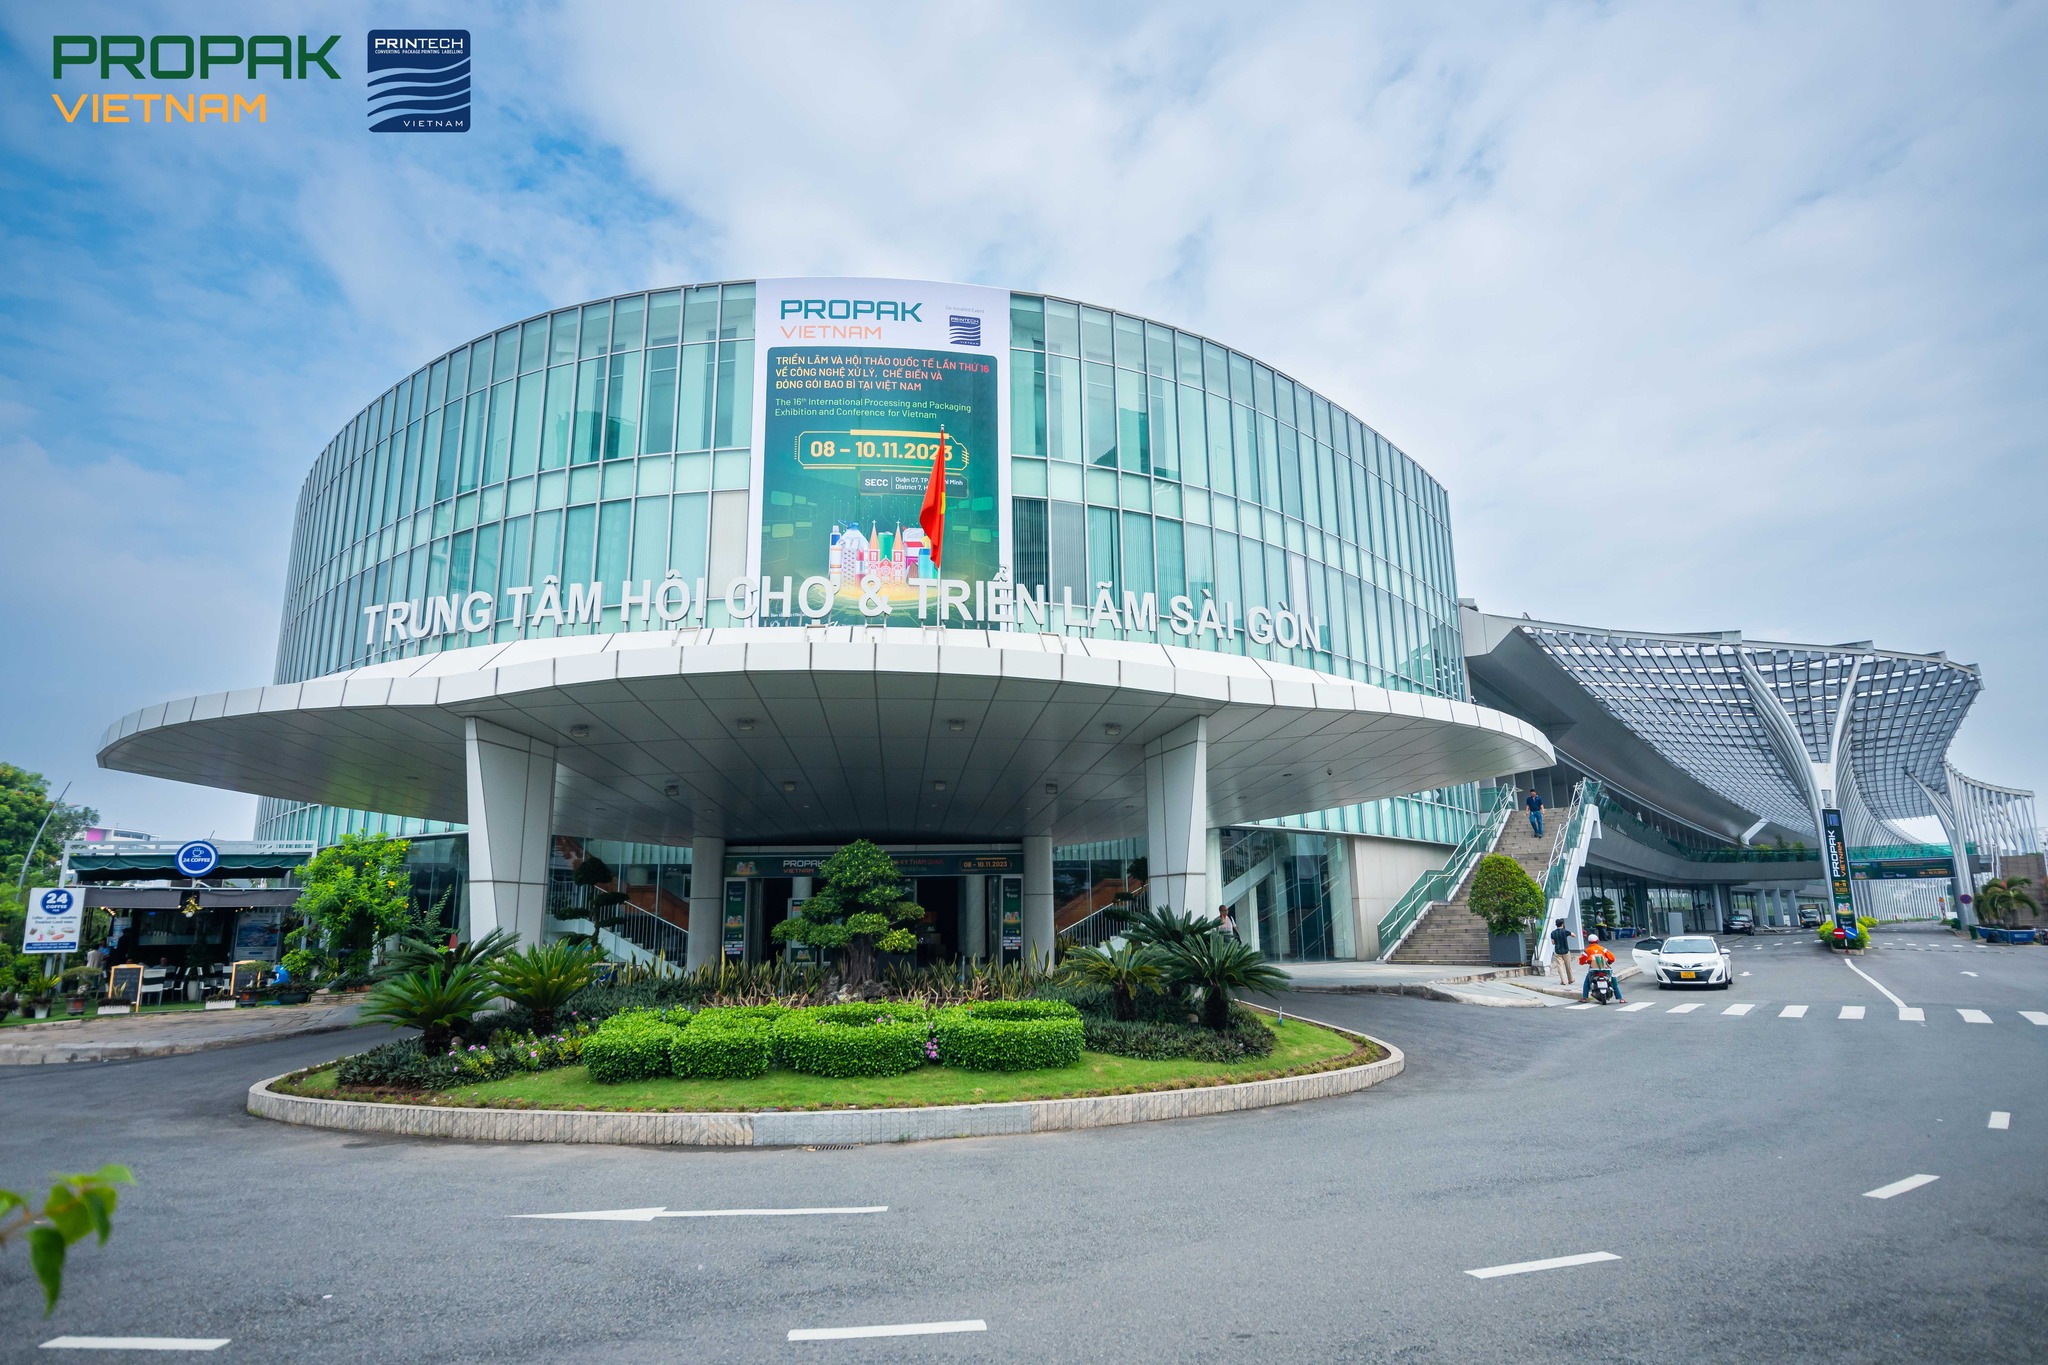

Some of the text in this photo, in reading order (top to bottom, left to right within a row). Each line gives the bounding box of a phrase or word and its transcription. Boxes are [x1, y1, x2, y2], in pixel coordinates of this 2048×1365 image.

[780, 299, 923, 322] PROPAK
[780, 325, 882, 340] VIETNAM
[776, 353, 804, 364] TRIỂN
[808, 354, 828, 364] LÃM
[831, 354, 843, 364] VÀ
[846, 354, 862, 366] HỘI
[864, 355, 890, 366] THẢO
[892, 356, 919, 367] QUỐC
[922, 358, 934, 368] TẾ
[980, 364, 990, 374] 16
[790, 366, 816, 376] CÔNG
[818, 366, 846, 378] NGHỆ
[882, 368, 903, 378] CHẾ
[905, 368, 928, 380] BIẾN
[930, 372, 942, 380] VÀ
[776, 379, 922, 391] ĐÓNG GÓI BAO BÌ TẠI VIỆT NAM
[775, 408, 817, 416] Exhibition
[836, 408, 885, 416] Conference
[902, 410, 937, 418] Vietnam
[776, 398, 791, 406] The
[808, 398, 862, 406] International
[864, 398, 910, 408] Processing
[930, 401, 972, 413] Packaging
[810, 440, 836, 458] 08
[864, 479, 889, 487] SECC
[363, 591, 494, 646] TRUNG
[506, 574, 603, 628] TÂM
[858, 574, 893, 617] &
[908, 564, 1045, 625] TRIỂN
[1064, 580, 1156, 632] LÃM
[1170, 588, 1235, 640] SÀI
[1247, 602, 1322, 652] GÒN
[1828, 830, 1841, 877] PROPAK
[1837, 842, 1846, 877] VIETNAM
[46, 893, 68, 904] 24
